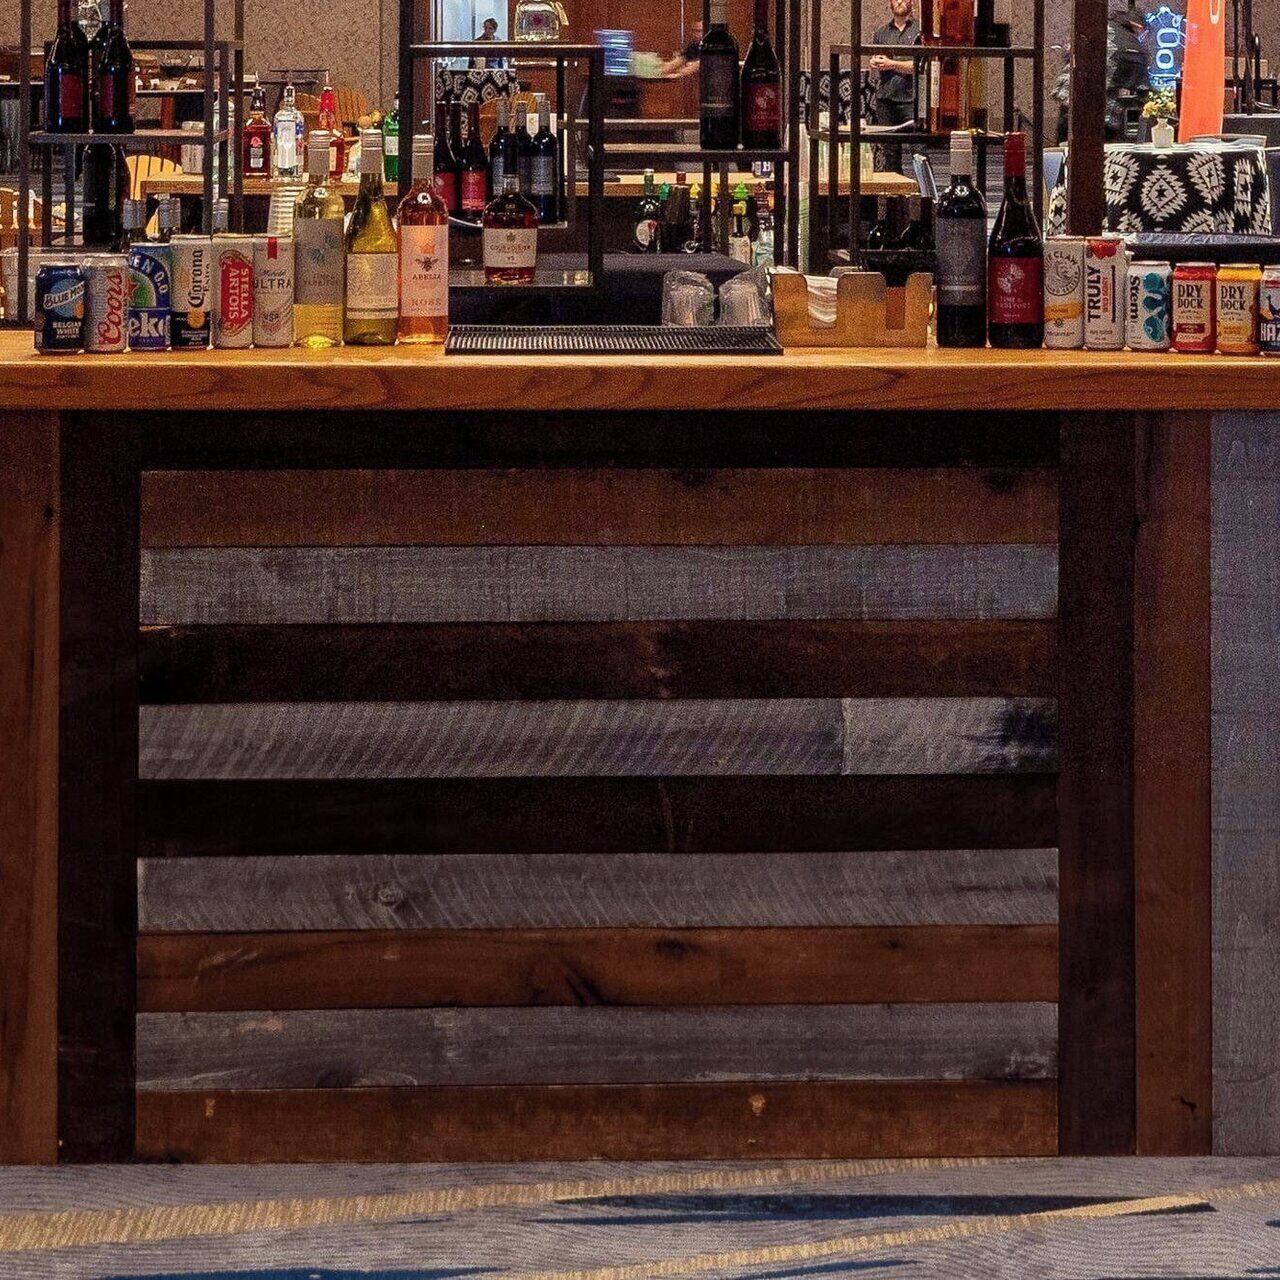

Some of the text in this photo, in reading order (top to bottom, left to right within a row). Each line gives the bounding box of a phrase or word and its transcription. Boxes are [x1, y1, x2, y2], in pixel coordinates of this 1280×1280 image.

[188, 249, 205, 308] Corona
[229, 267, 240, 320] ARTOIS
[240, 267, 251, 319] STELLA
[253, 278, 292, 289] ULTRA
[1087, 265, 1101, 323] TRULY
[1129, 275, 1141, 320] Stem
[1177, 284, 1203, 298] DRY
[1221, 285, 1246, 299] DRY
[98, 271, 123, 345] Coors
[1177, 298, 1204, 309] DOCK
[1220, 299, 1246, 311] DOCK
